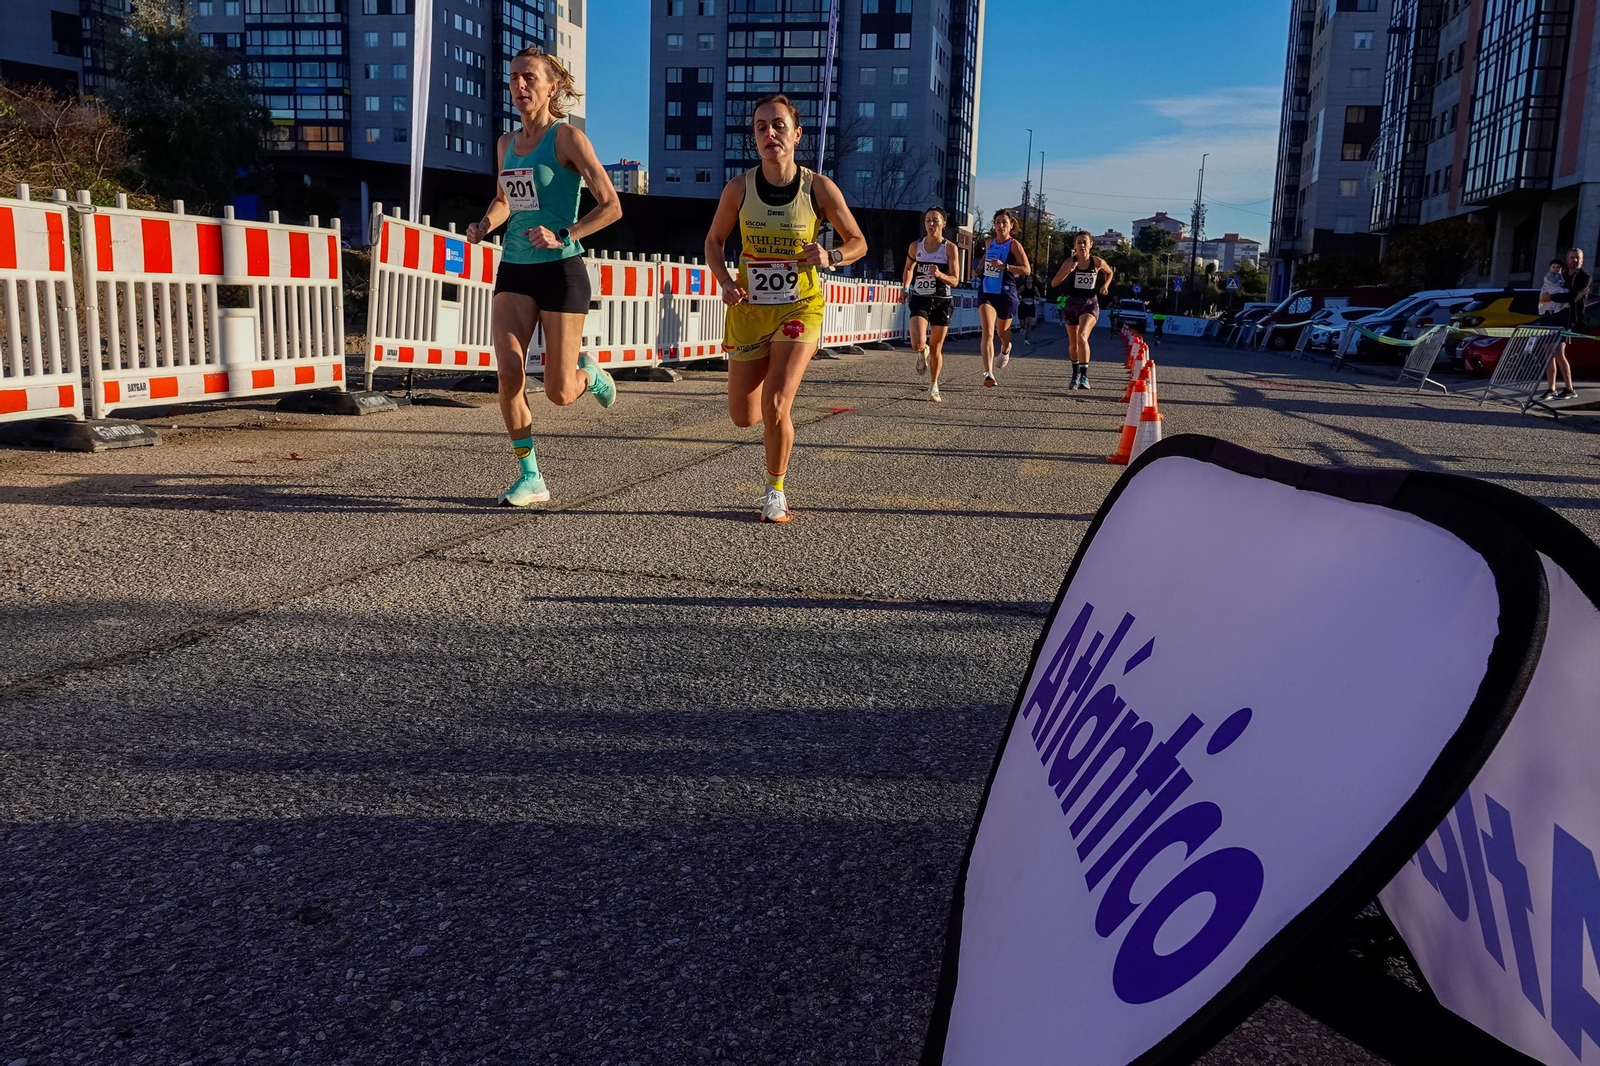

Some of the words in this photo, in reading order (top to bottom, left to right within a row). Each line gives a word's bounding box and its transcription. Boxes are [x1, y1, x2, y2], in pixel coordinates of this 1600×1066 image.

[507, 180, 535, 198] 201
[746, 235, 807, 247] ATHLETICS
[753, 245, 767, 254] San
[769, 246, 796, 256] Lázaro
[755, 272, 799, 291] 209
[917, 281, 936, 289] 205
[1078, 277, 1094, 285] 203
[1023, 602, 1264, 1004] Atlántico
